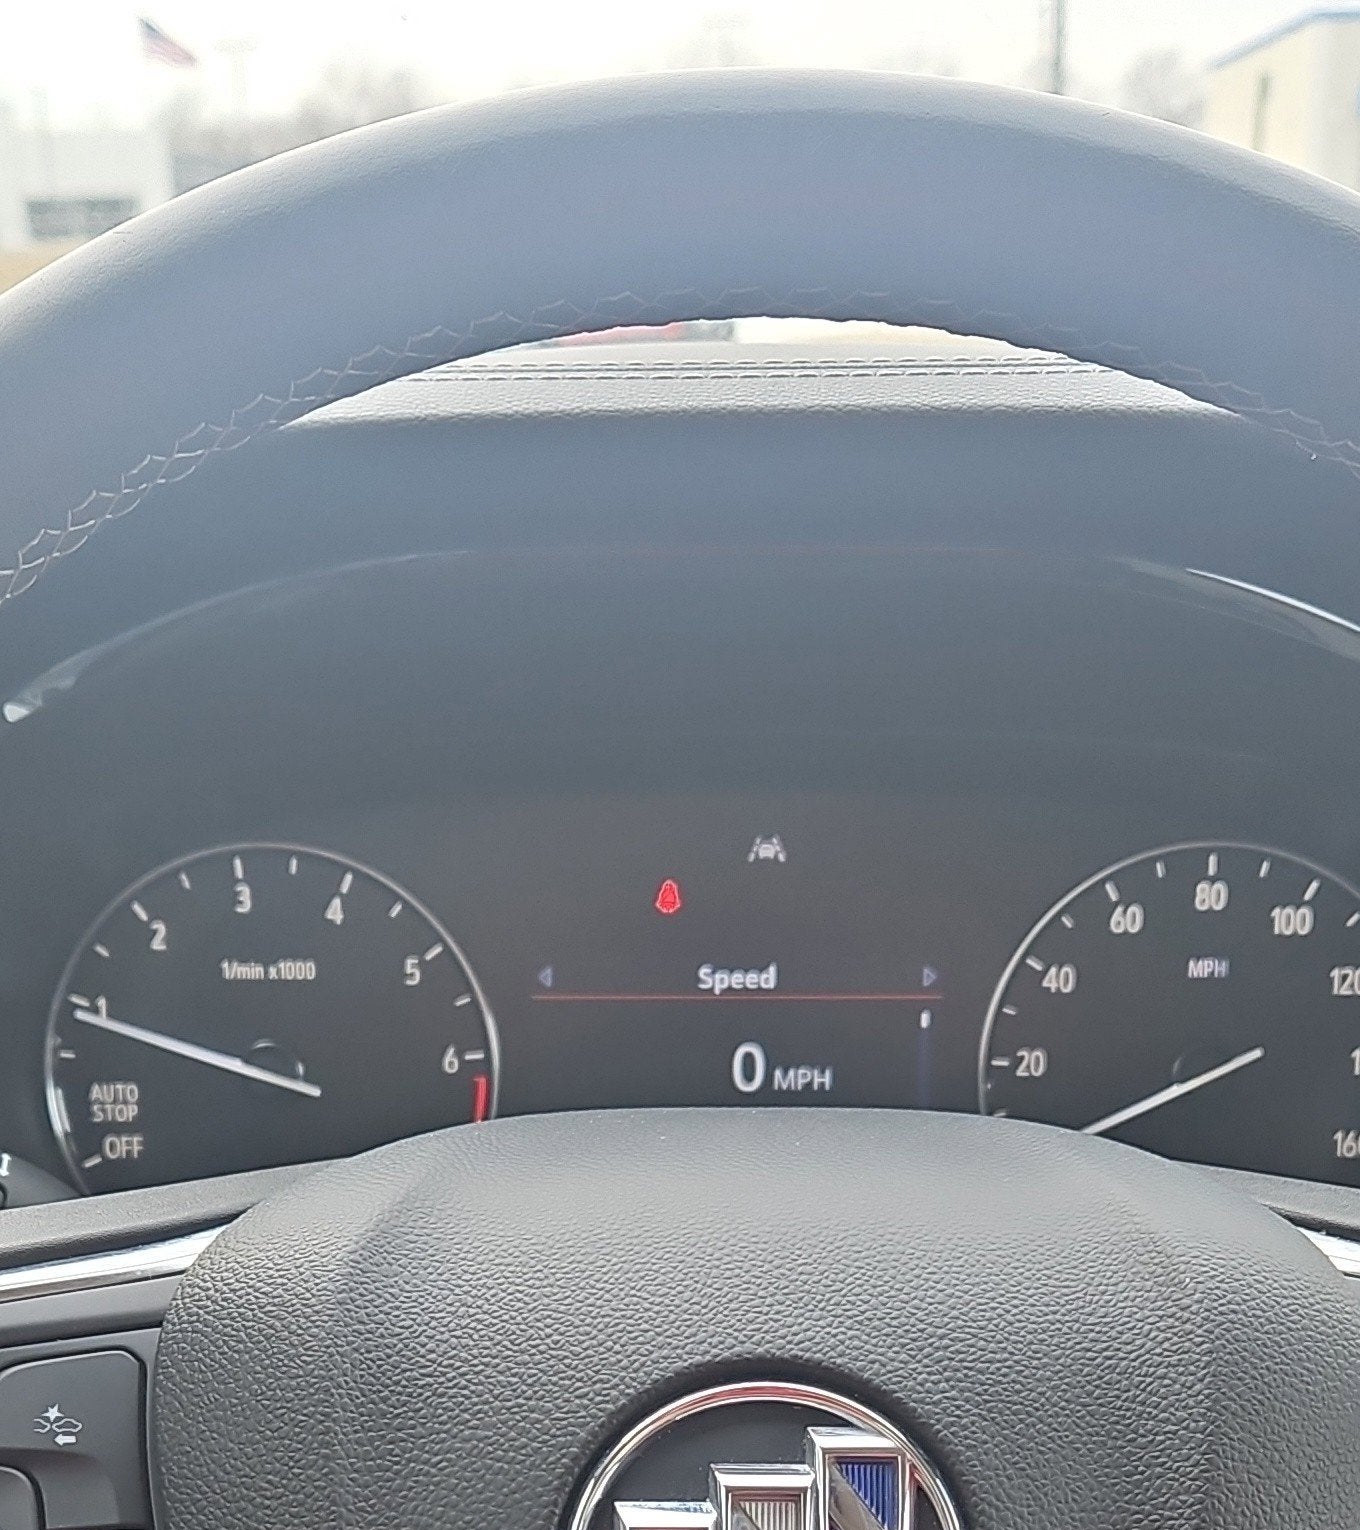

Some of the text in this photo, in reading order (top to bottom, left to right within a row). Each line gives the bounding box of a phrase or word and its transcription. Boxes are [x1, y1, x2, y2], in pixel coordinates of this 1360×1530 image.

[234, 883, 252, 913] 3
[1194, 880, 1229, 911] 80
[324, 897, 345, 925] 4
[1109, 902, 1145, 934] 60
[1270, 905, 1315, 936] 100
[149, 921, 167, 951] 2
[221, 960, 316, 981] 1/min x1000
[403, 957, 422, 987] 5
[697, 962, 778, 995] Speed
[1042, 964, 1077, 994] 40
[1187, 958, 1229, 979] MPH
[441, 1045, 460, 1074] 6
[731, 1041, 833, 1093] 0 MPH
[1015, 1047, 1048, 1078] 20
[89, 1081, 139, 1102] AUTO
[91, 1104, 139, 1123] STOP
[102, 1137, 144, 1159] OFF
